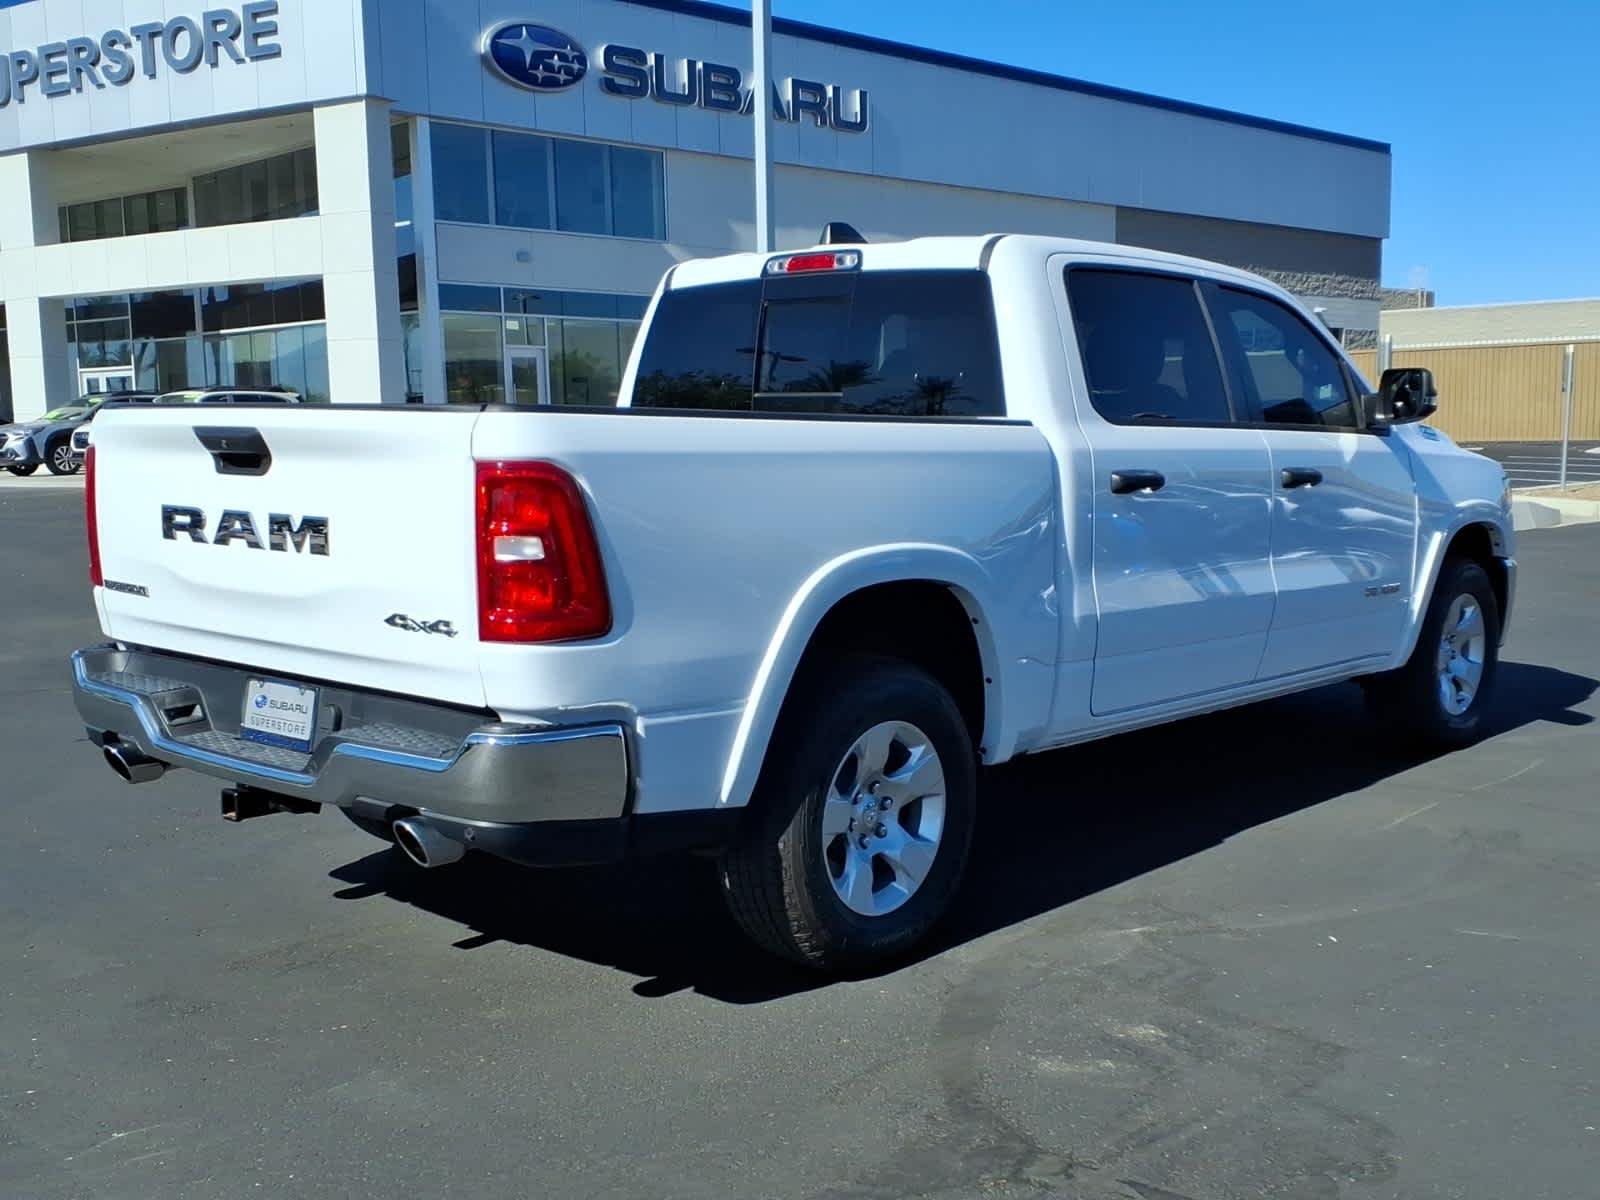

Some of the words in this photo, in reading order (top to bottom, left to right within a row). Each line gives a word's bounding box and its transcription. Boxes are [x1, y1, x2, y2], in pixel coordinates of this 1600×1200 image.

[161, 503, 330, 556] RAM
[269, 698, 308, 714] SUBARU
[250, 716, 306, 735] SUPERSTORE
